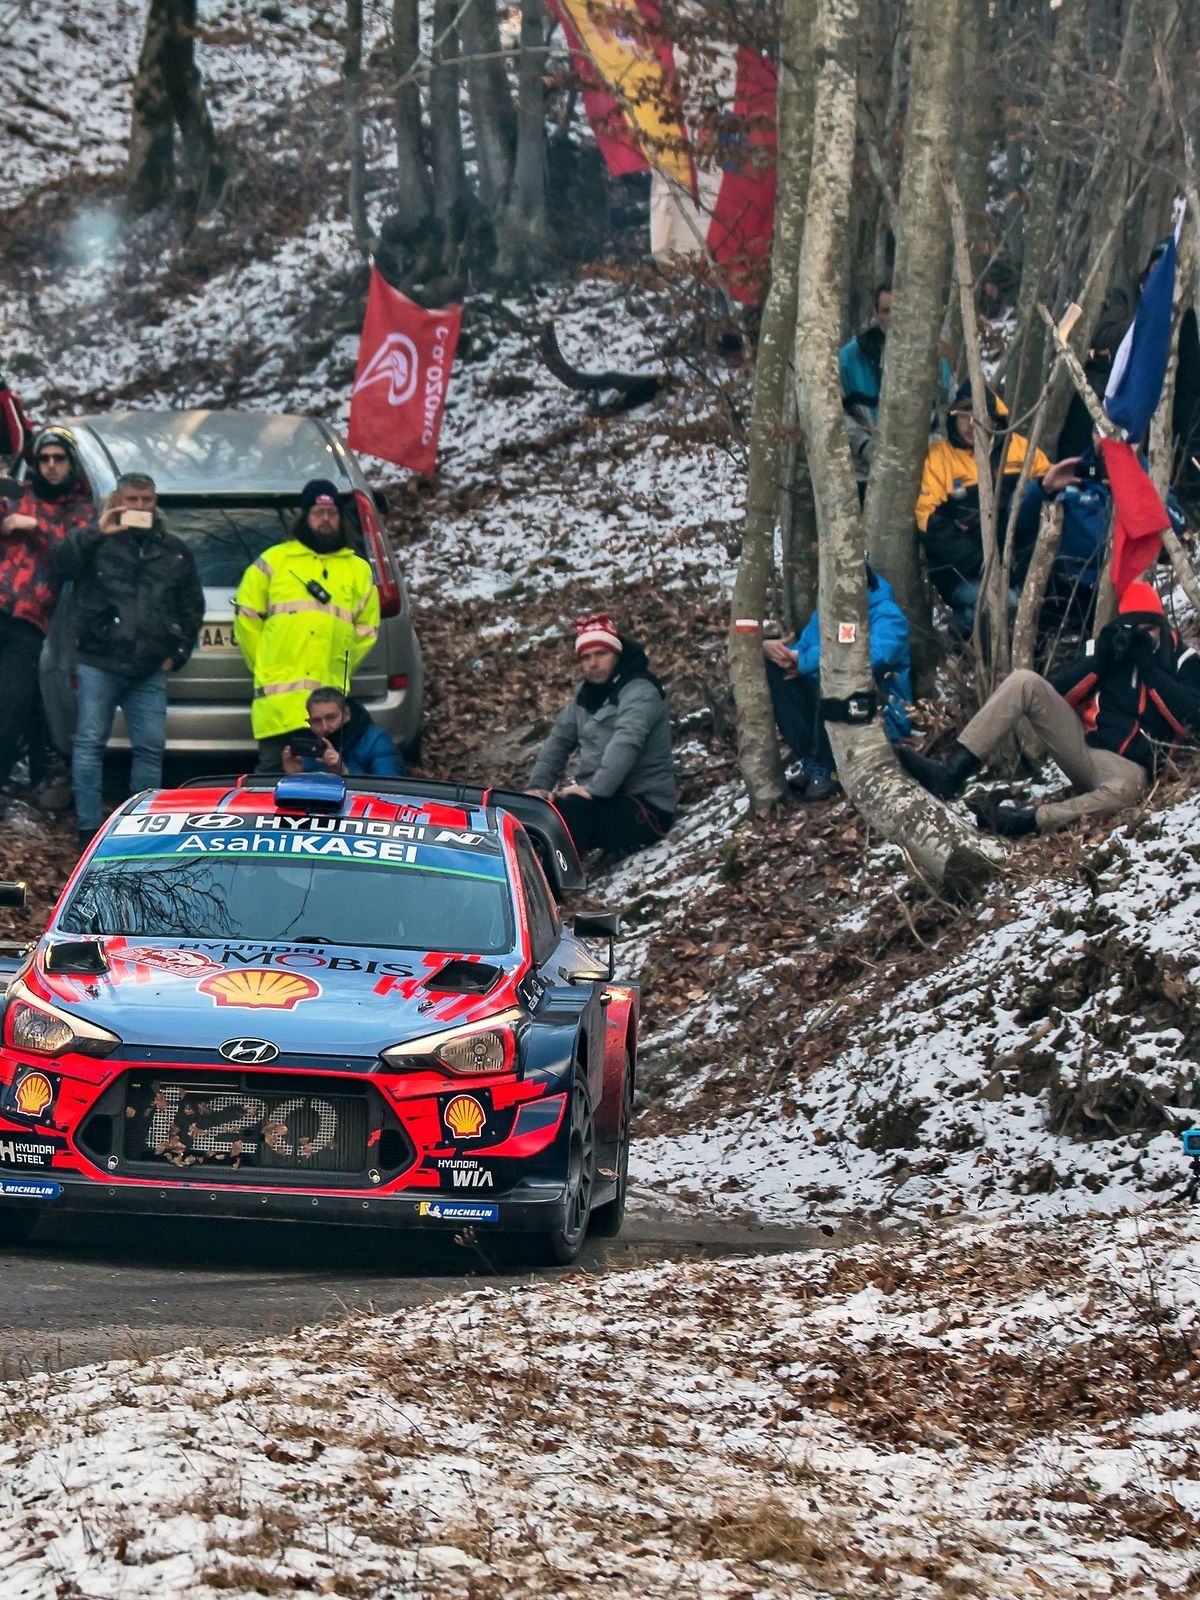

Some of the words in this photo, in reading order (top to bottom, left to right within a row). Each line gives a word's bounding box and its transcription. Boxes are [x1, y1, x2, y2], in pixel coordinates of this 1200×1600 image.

[137, 815, 168, 833] 19
[256, 815, 426, 839] HYUNDAI
[176, 834, 418, 863] AsahiKASEI
[178, 943, 325, 955] HYUNDAI
[220, 951, 414, 978] MOBIS
[15, 1142, 55, 1155] HYUNDAI
[16, 1153, 45, 1165] STEEL
[438, 1160, 478, 1169] HYUNDAI
[5, 1185, 54, 1195] MICHELIN
[443, 1208, 493, 1217] MICHELIN
